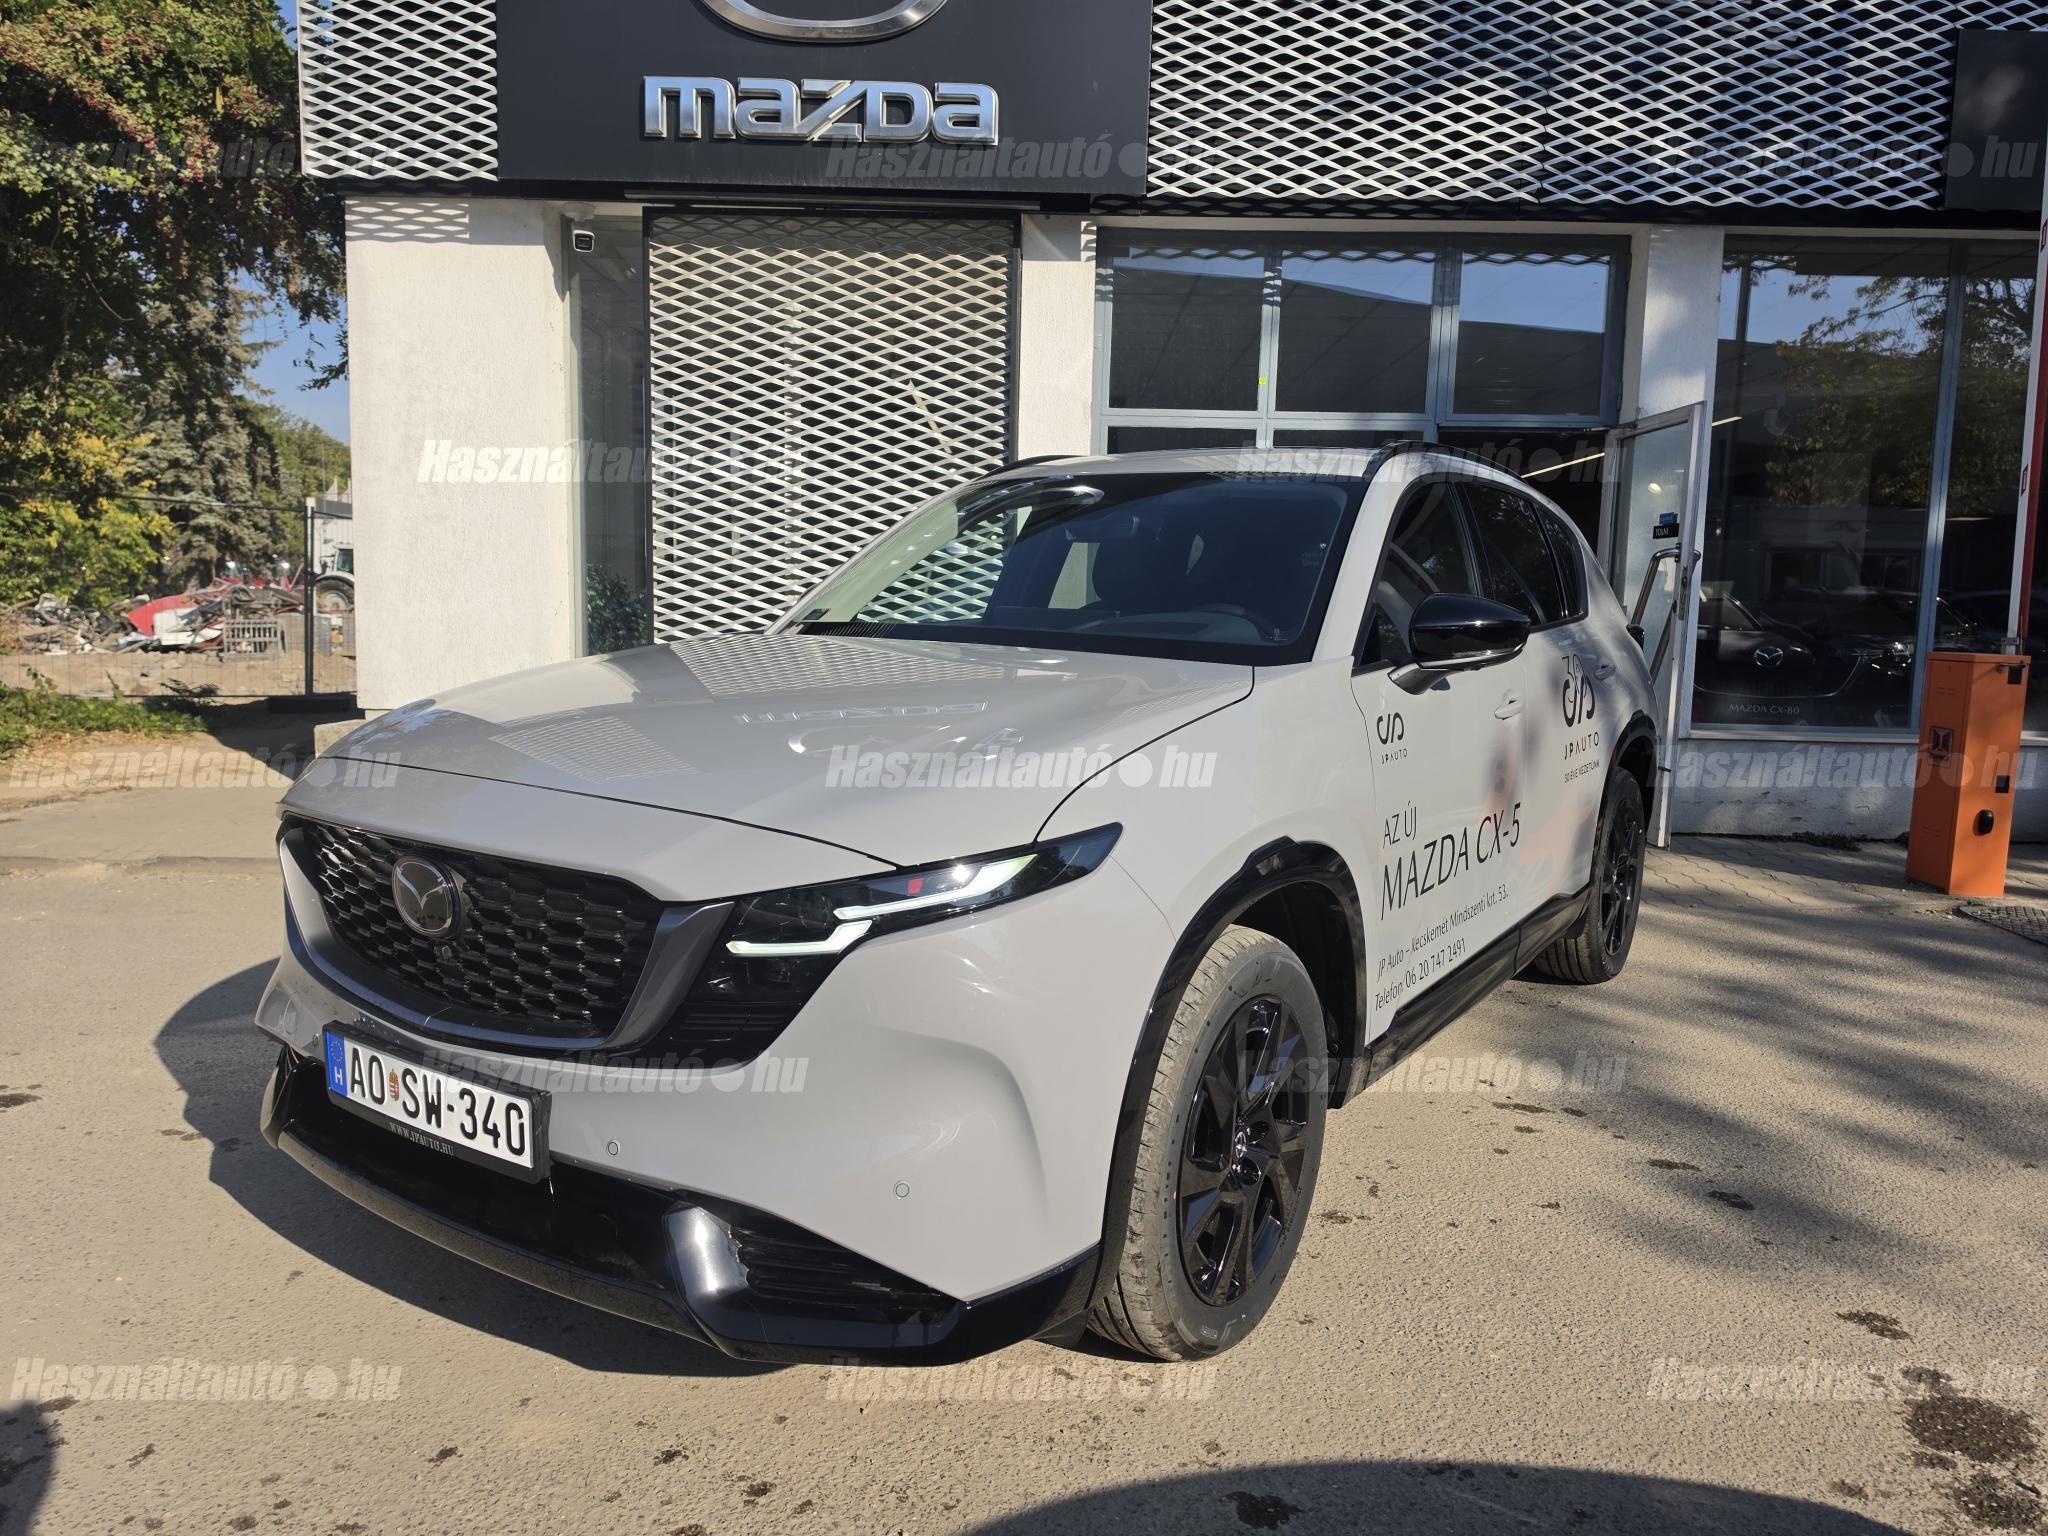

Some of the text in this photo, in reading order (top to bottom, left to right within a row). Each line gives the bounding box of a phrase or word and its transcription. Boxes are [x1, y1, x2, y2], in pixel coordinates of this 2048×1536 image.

[1729, 703, 1767, 713] MAZDA
[1383, 800, 1417, 848] AZ ÚJ
[1381, 802, 1521, 920] MAZDA CX-5
[1377, 958, 1386, 984] JP
[1387, 949, 1404, 973] Auto
[1449, 895, 1487, 930] Mindszenti
[1498, 883, 1509, 902] 53.
[1405, 970, 1417, 989] 06
[1419, 959, 1430, 982] 20
[1430, 949, 1446, 973] 747
[1448, 937, 1467, 962] 2491
[333, 1066, 344, 1086] H
[350, 1047, 526, 1157] AO SW-340
[389, 1120, 455, 1157] WWW.JPAUTO.HU
